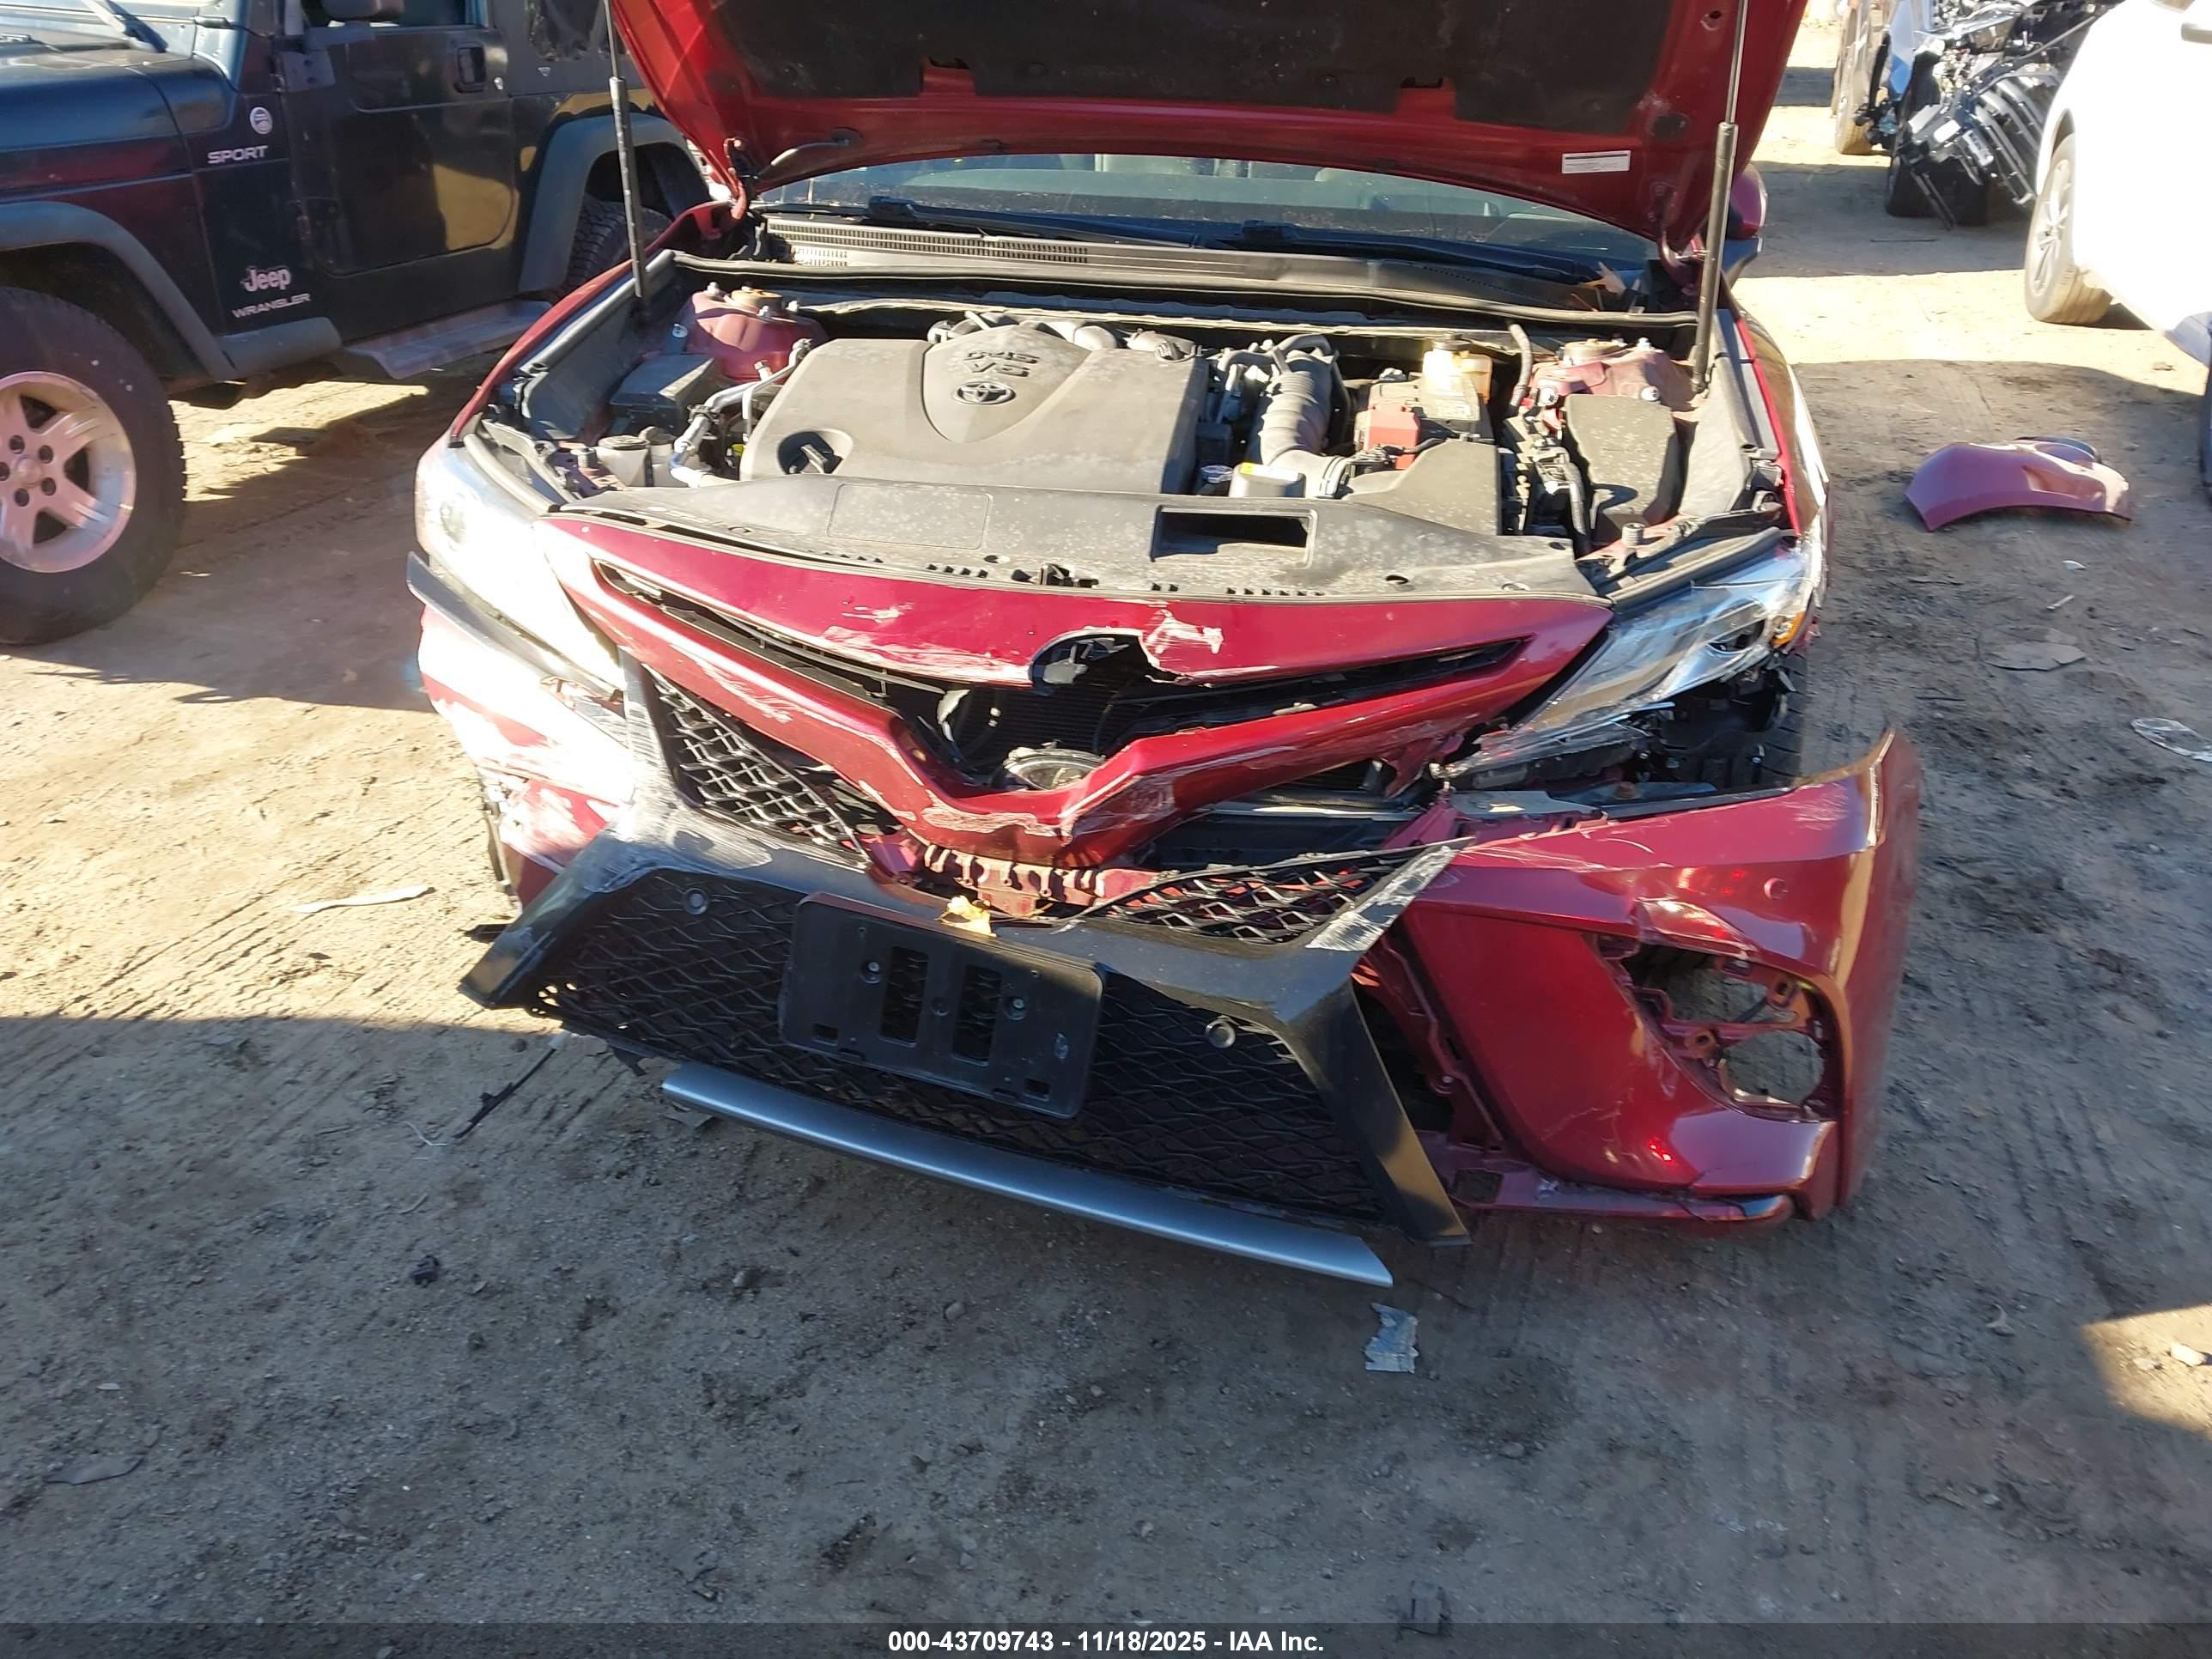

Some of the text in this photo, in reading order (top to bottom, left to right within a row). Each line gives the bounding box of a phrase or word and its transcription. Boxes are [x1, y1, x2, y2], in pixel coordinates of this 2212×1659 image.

[207, 145, 269, 164] SPORT
[241, 265, 291, 292] Jeep
[231, 293, 311, 318] WRANGLER
